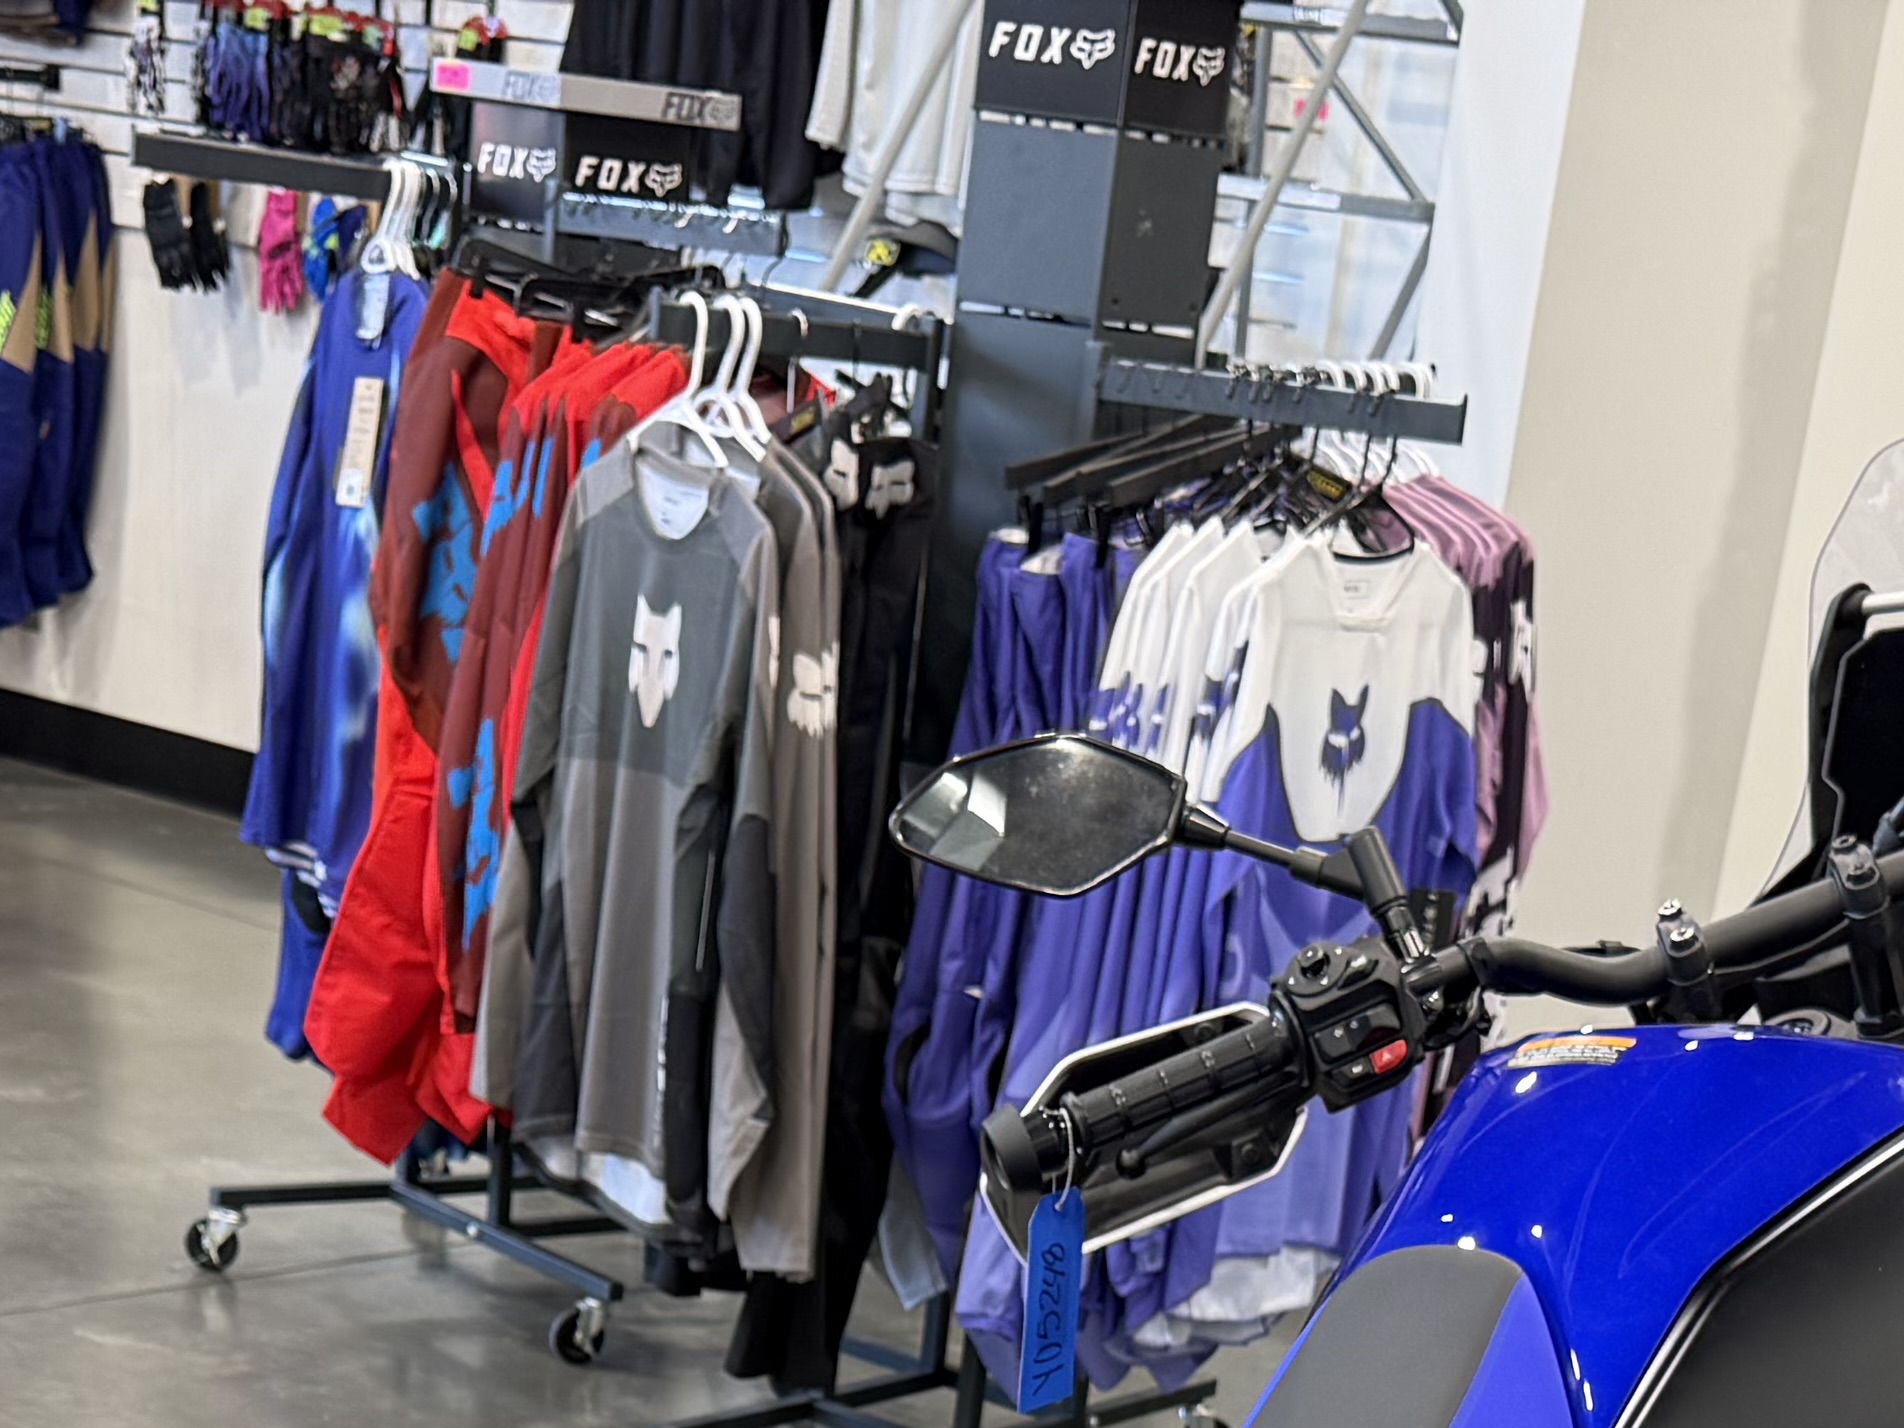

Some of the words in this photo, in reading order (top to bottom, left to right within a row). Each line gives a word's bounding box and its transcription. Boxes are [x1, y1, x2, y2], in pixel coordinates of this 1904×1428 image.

[989, 21, 1072, 64] FOX
[1134, 37, 1195, 81] FOX
[477, 142, 528, 178] FOX
[574, 155, 645, 193] FOX
